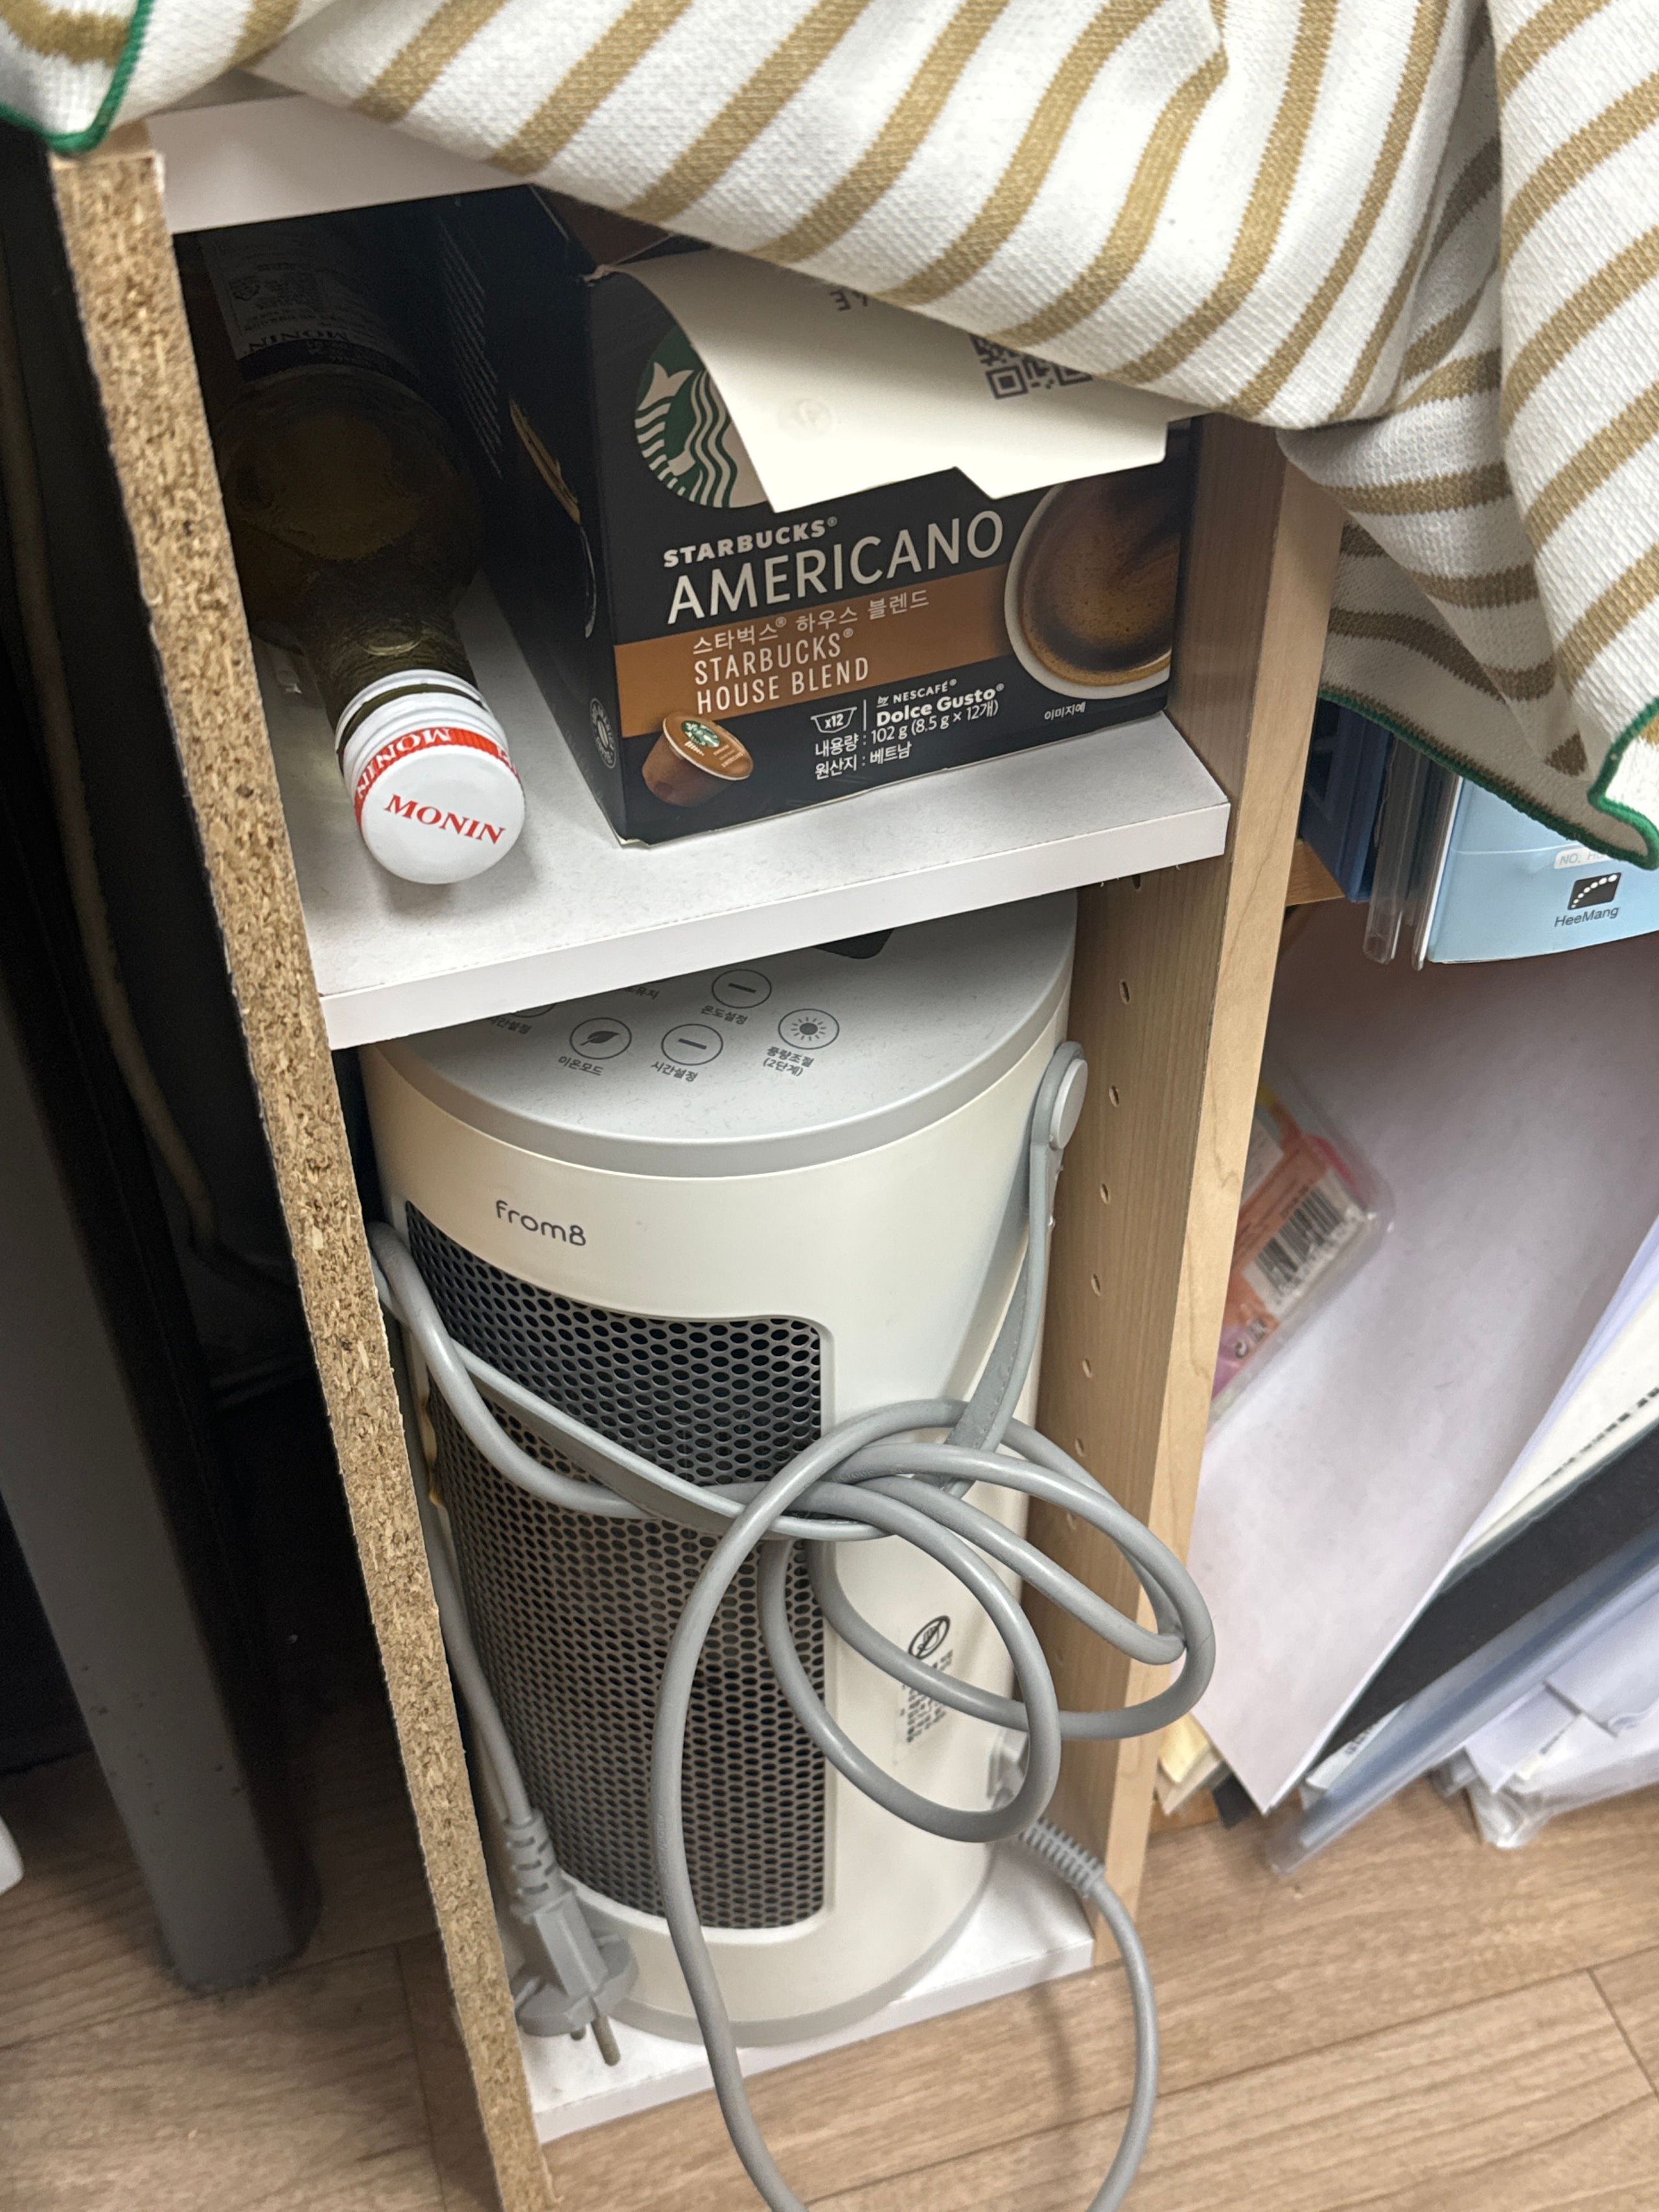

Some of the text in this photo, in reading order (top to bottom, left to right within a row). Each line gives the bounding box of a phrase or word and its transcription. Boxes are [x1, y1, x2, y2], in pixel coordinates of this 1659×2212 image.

[667, 511, 1003, 625] AMERICANO
[795, 607, 858, 633] 하우스
[868, 590, 929, 620] 블렌드
[697, 657, 869, 715] HOUSE BLEND
[877, 703, 933, 727] Dolce
[1044, 701, 1086, 721] 이미지예
[815, 733, 859, 757] 내용량
[871, 727, 894, 744] 102
[815, 754, 857, 780] 원산지
[870, 741, 912, 764] 베트남
[384, 794, 506, 844] MONIN
[1554, 907, 1619, 927] HeeMang
[701, 1005, 748, 1025] 온도설정
[559, 1056, 604, 1076] 이온모드
[651, 1061, 698, 1082] 시간설정
